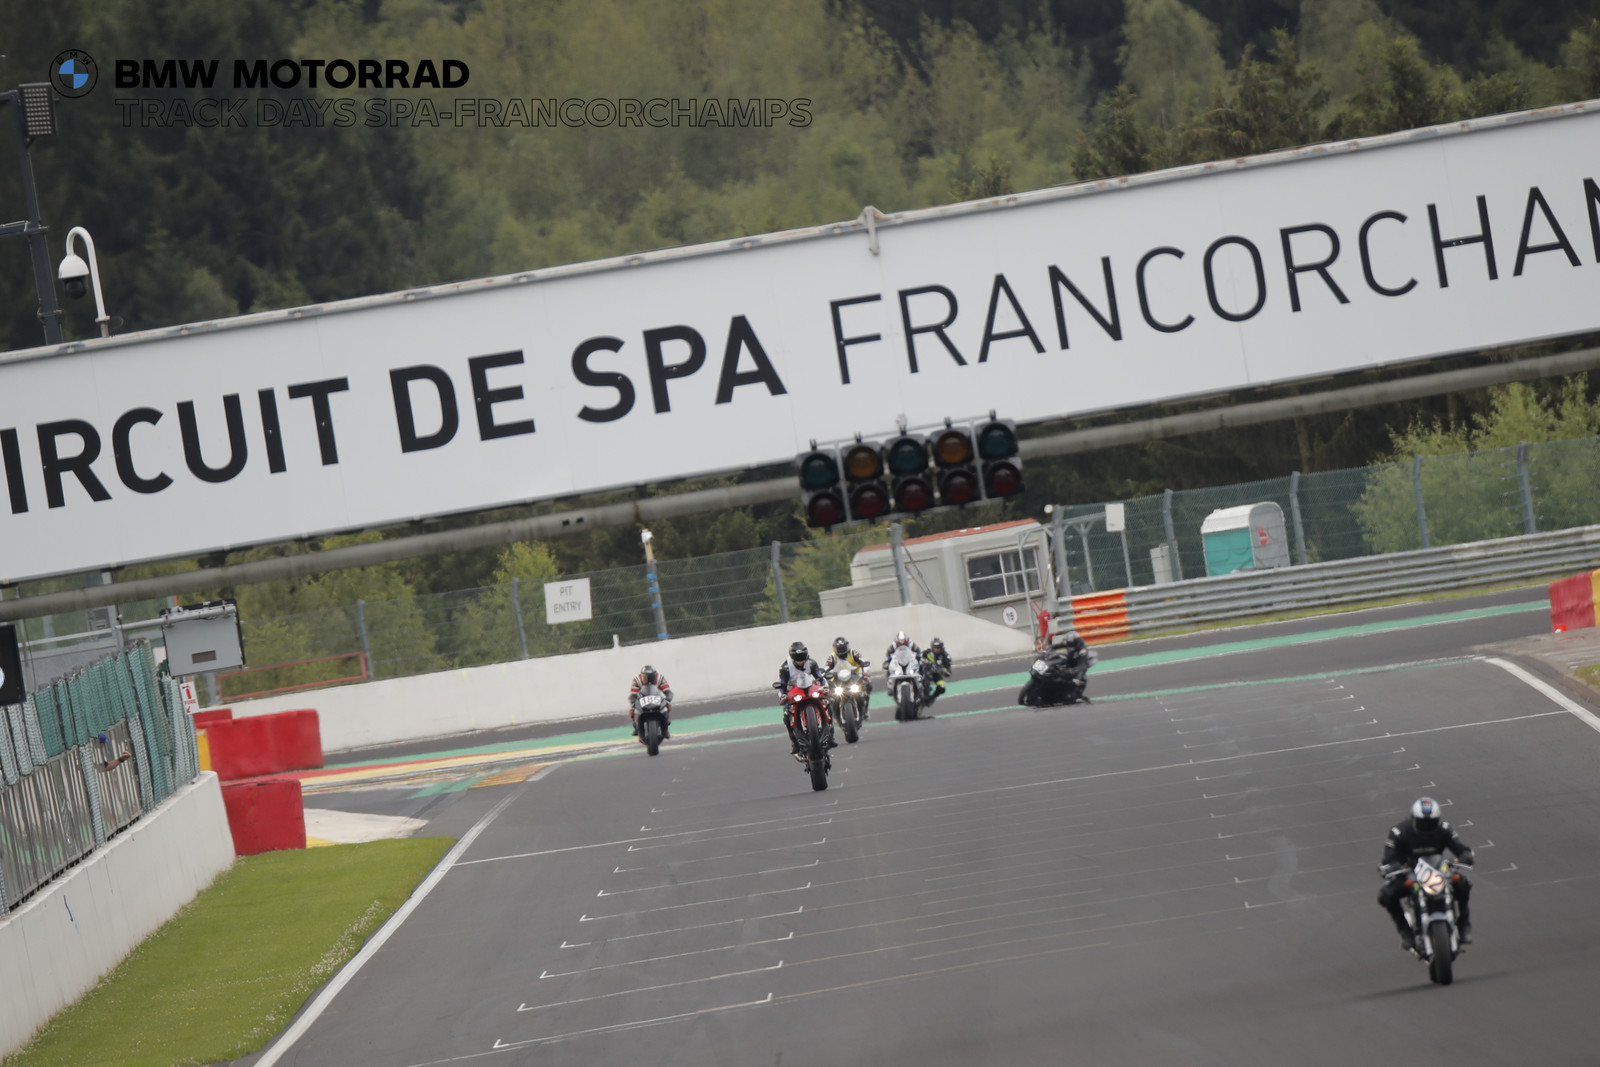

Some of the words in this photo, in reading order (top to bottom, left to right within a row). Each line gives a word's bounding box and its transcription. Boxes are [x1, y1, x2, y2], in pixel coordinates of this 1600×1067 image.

[389, 350, 536, 454] DE
[571, 315, 788, 424] SPA
[829, 177, 1600, 385] FRANCORCHA
[559, 585, 573, 597] PIT
[553, 600, 582, 614] ENTRY
